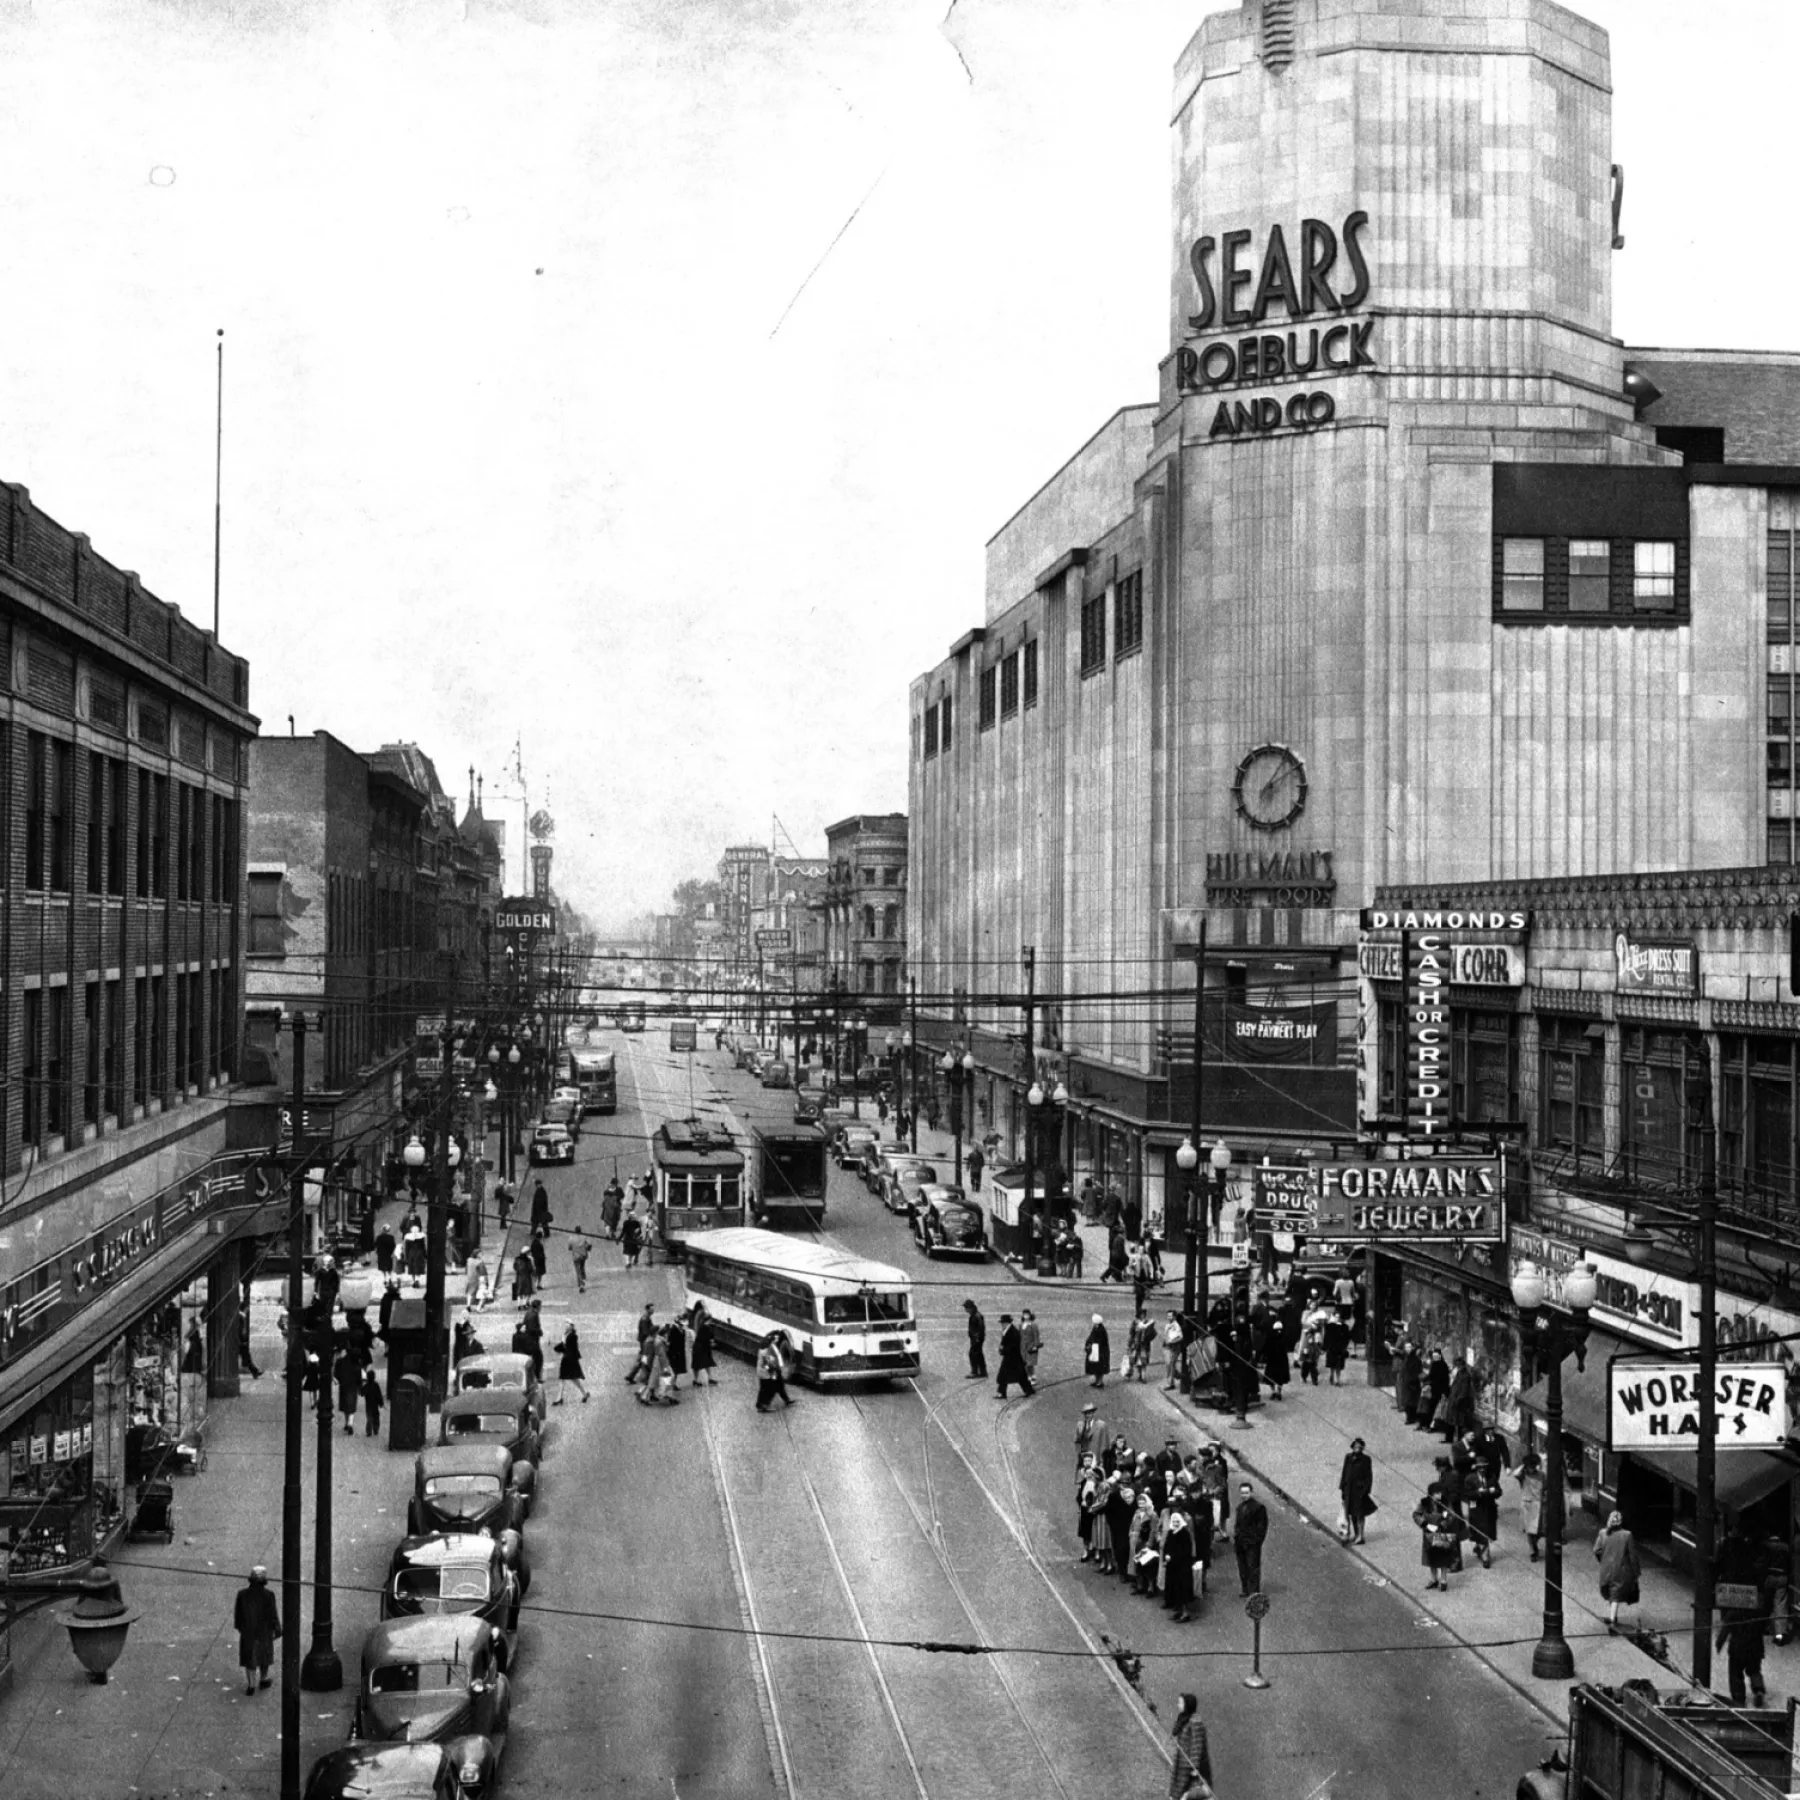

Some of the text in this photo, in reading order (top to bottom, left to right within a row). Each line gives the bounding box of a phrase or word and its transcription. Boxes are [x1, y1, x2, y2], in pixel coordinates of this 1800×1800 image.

[1188, 210, 1370, 330] SEARS
[1177, 320, 1376, 390] ROEBUCK
[1209, 391, 1335, 438] AND CO
[725, 850, 767, 861] GENERAL
[496, 913, 550, 928] GOLDEN
[739, 863, 748, 957] FURNITURE
[1372, 912, 1525, 929] DIAMONDS
[1360, 946, 1400, 977] CITIZE
[1417, 935, 1441, 1006] CASH
[1236, 1021, 1257, 1037] EASY
[1258, 1024, 1293, 1039] PAYMENT
[1415, 1011, 1442, 1023] OR
[1417, 1028, 1441, 1135] CREDIT
[1355, 1205, 1483, 1230] JEWELRY
